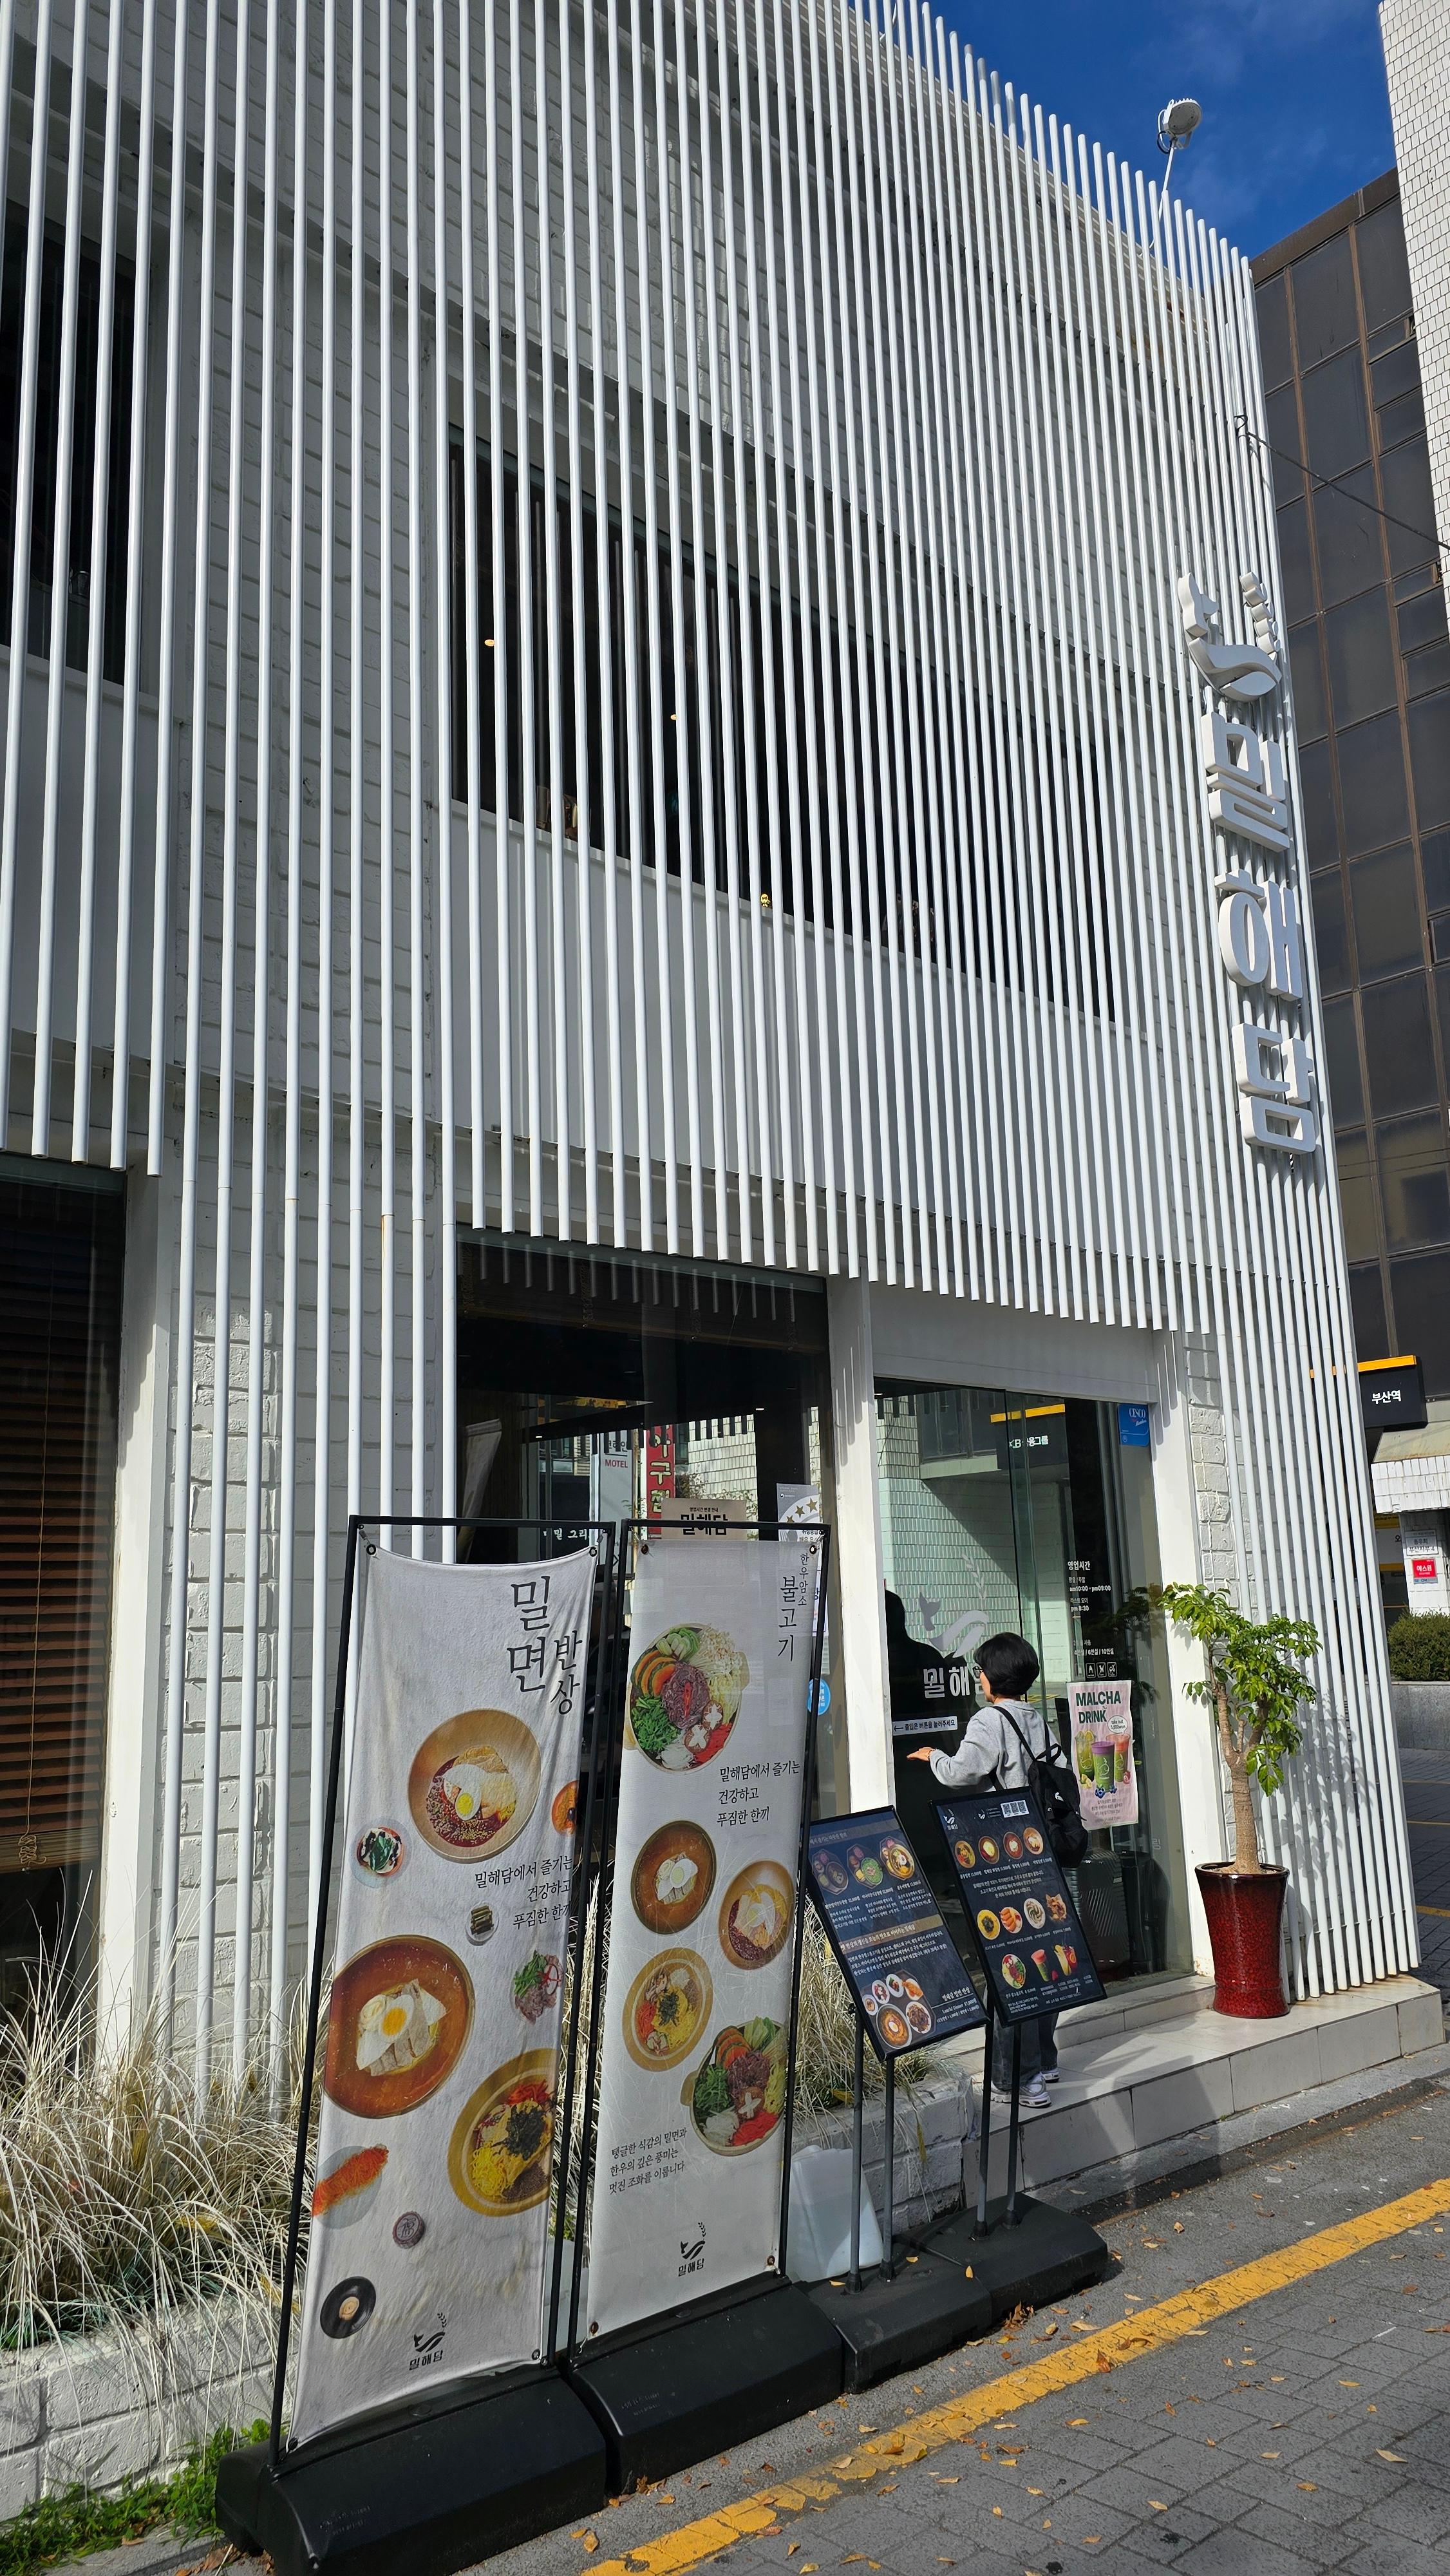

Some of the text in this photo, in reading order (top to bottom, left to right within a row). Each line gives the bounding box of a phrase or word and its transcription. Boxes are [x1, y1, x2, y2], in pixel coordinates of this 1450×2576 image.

[1201, 712, 1315, 1155] 밀해담
[1371, 1389, 1402, 1404] 부산역
[1129, 1408, 1146, 1418] CESCO
[1009, 1435, 1049, 1448] KB융그룹
[605, 1459, 628, 1468] MOTEL
[567, 1528, 588, 1540] 그리
[1068, 1560, 1091, 1571] 영업시간
[798, 1552, 809, 1605] 한우암소
[778, 1575, 798, 1662] 불고기
[507, 1575, 550, 1692] 밀면
[551, 1630, 583, 1715] 반상
[1075, 1690, 1122, 1707] MALCHA
[919, 1721, 932, 1730] 버튼을
[1078, 1710, 1107, 1724] DRINK
[720, 1760, 800, 1783] 밀해담에서 즐기는
[718, 1787, 759, 1804] 건강하고
[717, 1806, 769, 1828] 푸짐한 한끼
[475, 1855, 572, 1889] 밀해담에서 즐기는
[527, 1879, 571, 1902] 건강하고
[513, 1907, 549, 1929] 푸짐한
[611, 2127, 688, 2159] 탱글한 식감의 밀면과
[610, 2148, 679, 2177] 한우의 깊은 풍미는
[609, 2161, 685, 2195] 멋진 조화를 이룹니다
[678, 2258, 704, 2277] 밀해담
[409, 2349, 443, 2371] 밀해담
